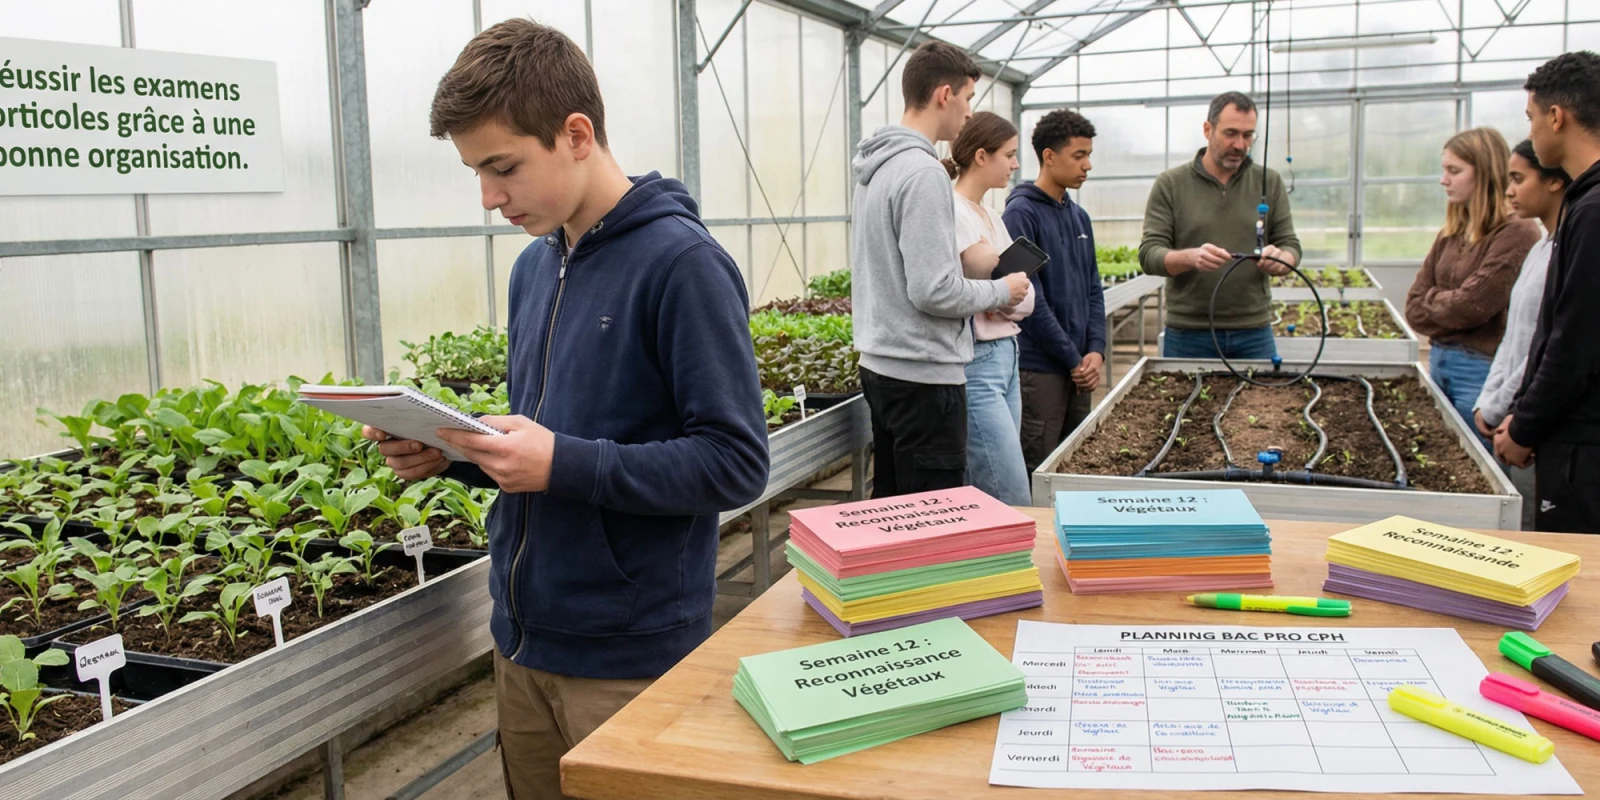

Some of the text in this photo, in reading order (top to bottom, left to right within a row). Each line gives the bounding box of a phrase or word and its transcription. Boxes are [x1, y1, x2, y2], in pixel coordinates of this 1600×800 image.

[90, 66, 125, 94] les
[133, 77, 241, 101] examens
[117, 106, 185, 138] grâce
[192, 109, 205, 134] à
[213, 117, 256, 136] une
[88, 143, 248, 174] organisation.
[839, 501, 916, 518] Semaine
[919, 498, 942, 507] 12
[1097, 496, 1172, 504] Semaine
[1113, 505, 1197, 514] Végétaux
[834, 503, 980, 529] Reconnaissance
[878, 516, 968, 533] Végétaux
[1412, 527, 1485, 549] Semaine
[1488, 546, 1513, 556] 12
[1120, 631, 1345, 642] PLANNING BAC PRO CPH
[794, 648, 963, 690] Reconnaissance
[799, 647, 890, 671] Semaine
[893, 639, 921, 651] 12
[841, 669, 946, 698] Végétaux
